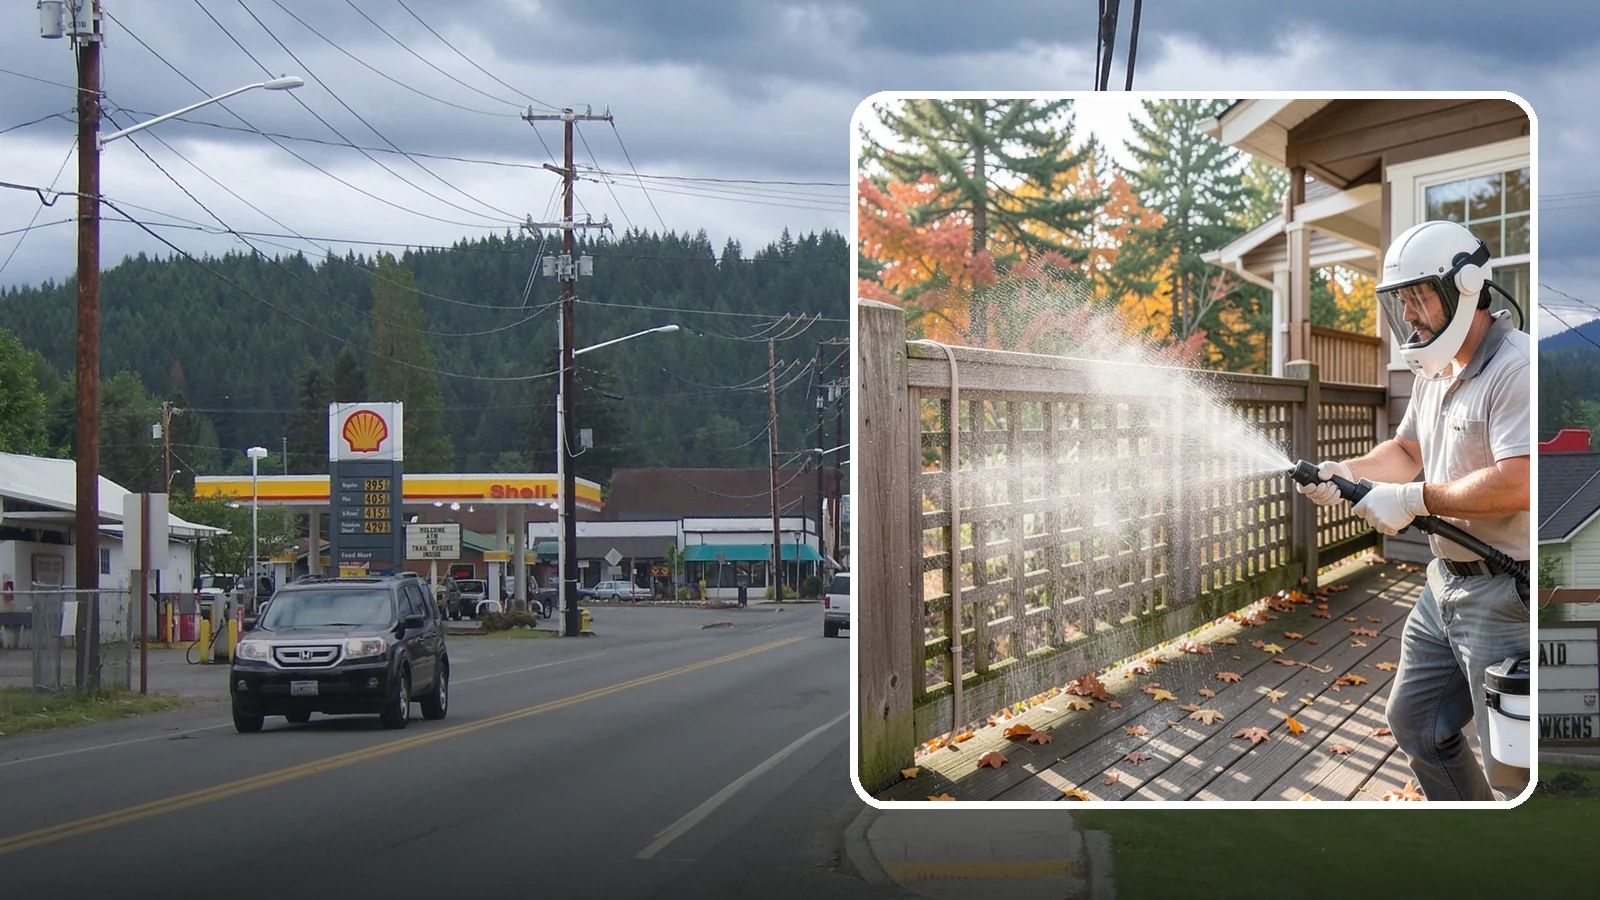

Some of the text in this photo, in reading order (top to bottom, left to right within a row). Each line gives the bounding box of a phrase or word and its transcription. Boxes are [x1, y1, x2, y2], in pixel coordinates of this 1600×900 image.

[366, 480, 383, 490] 395
[490, 484, 547, 499] Shell
[366, 494, 383, 504] 405
[366, 508, 383, 518] 415
[366, 522, 383, 532] 429
